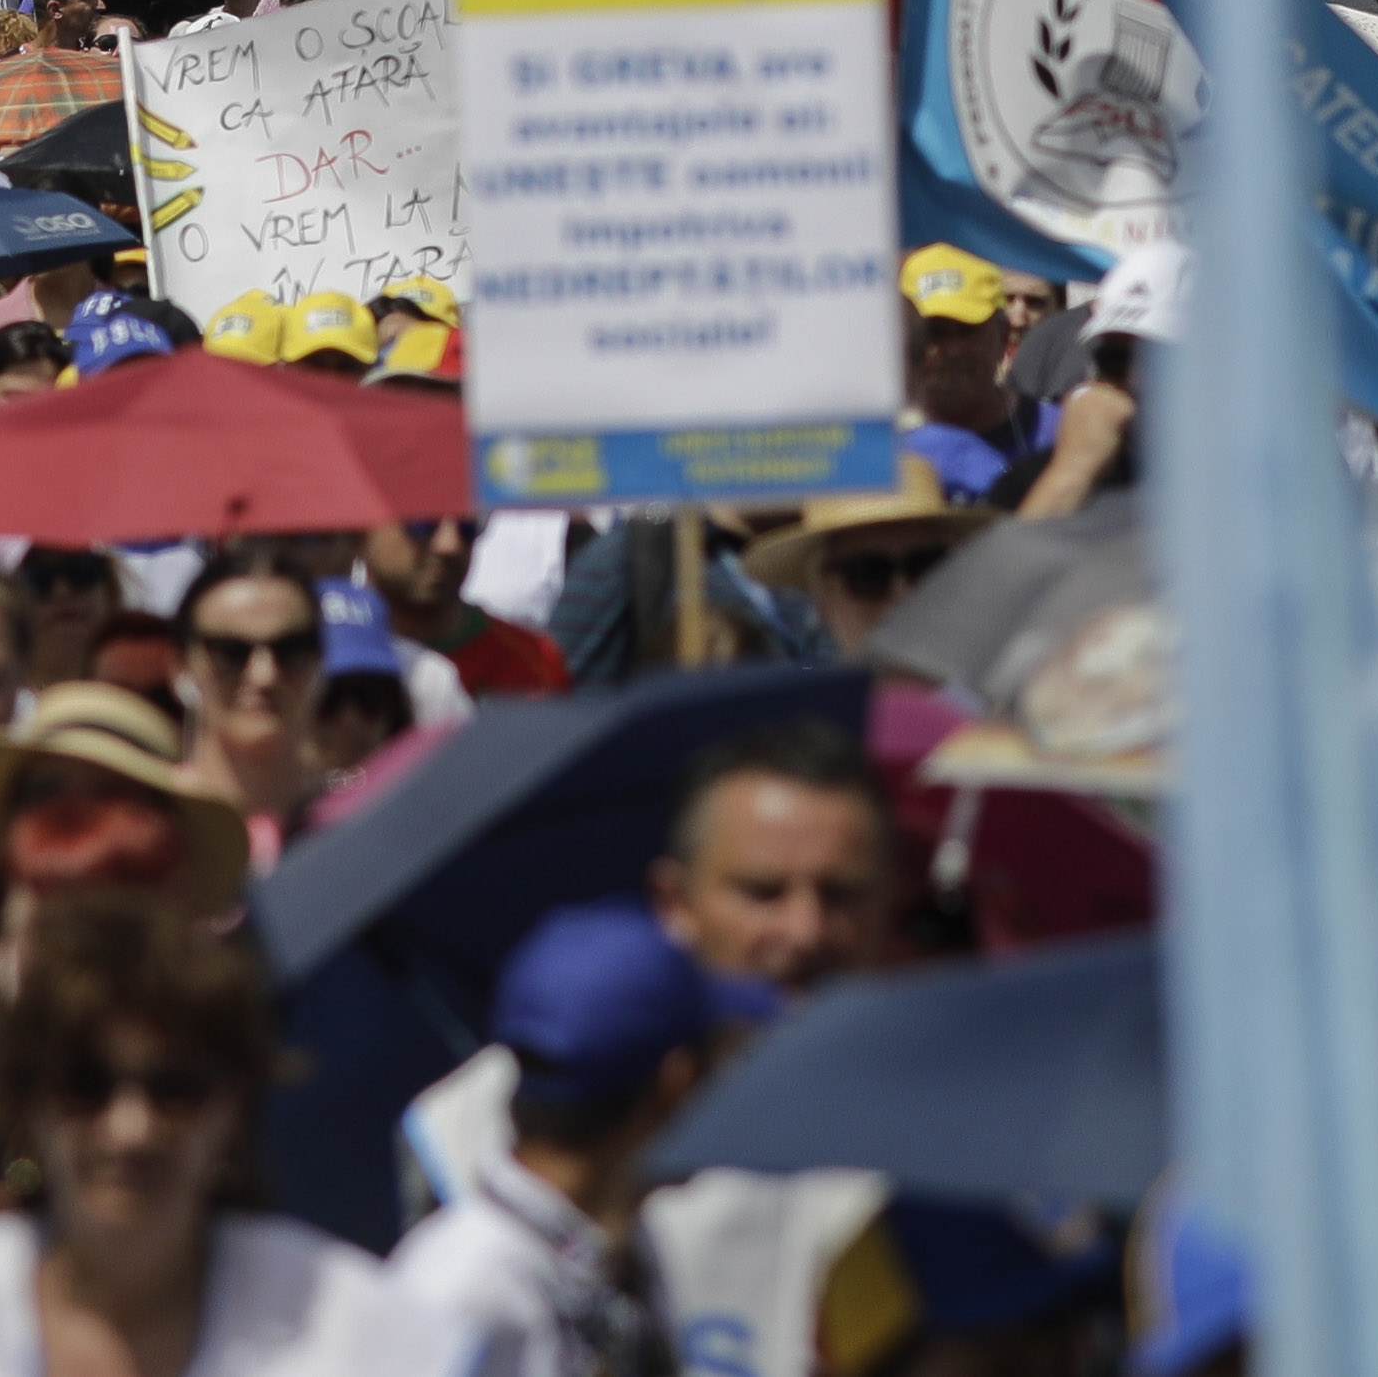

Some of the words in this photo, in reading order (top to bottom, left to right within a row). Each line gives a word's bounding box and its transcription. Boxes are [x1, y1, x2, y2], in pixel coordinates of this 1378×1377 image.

[144, 38, 261, 94] VREM
[219, 98, 274, 140] CA
[239, 202, 357, 255] VREM
[385, 186, 433, 235] LA
